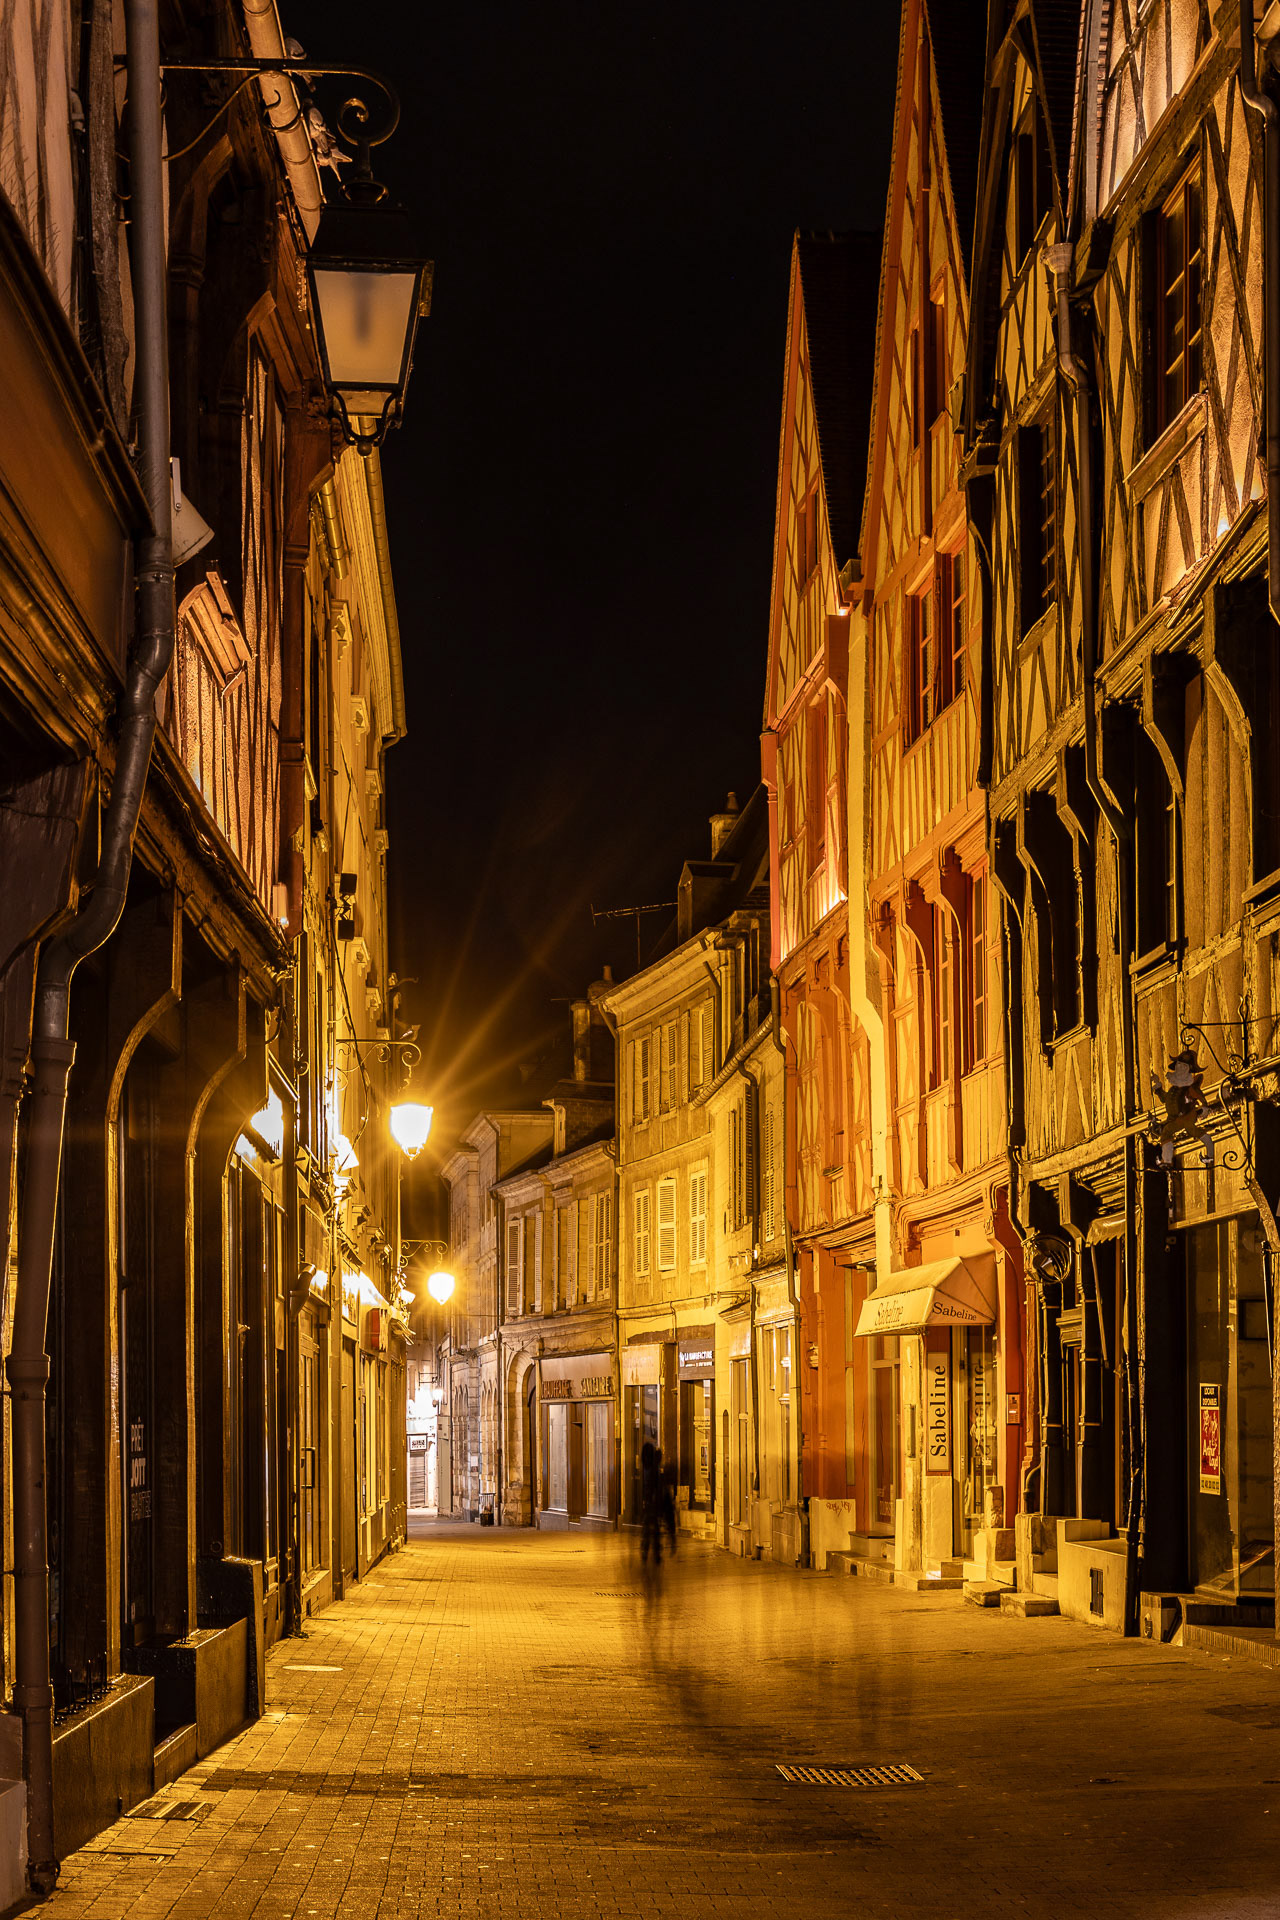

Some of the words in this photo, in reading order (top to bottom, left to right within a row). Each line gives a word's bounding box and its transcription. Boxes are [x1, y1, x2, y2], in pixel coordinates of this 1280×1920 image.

[932, 1301, 977, 1321] Sabeline
[580, 1376, 613, 1397] SANITAIRE
[930, 1365, 947, 1457] Sabeline
[131, 1416, 145, 1452] PRÊT
[130, 1458, 146, 1488] JOTT
